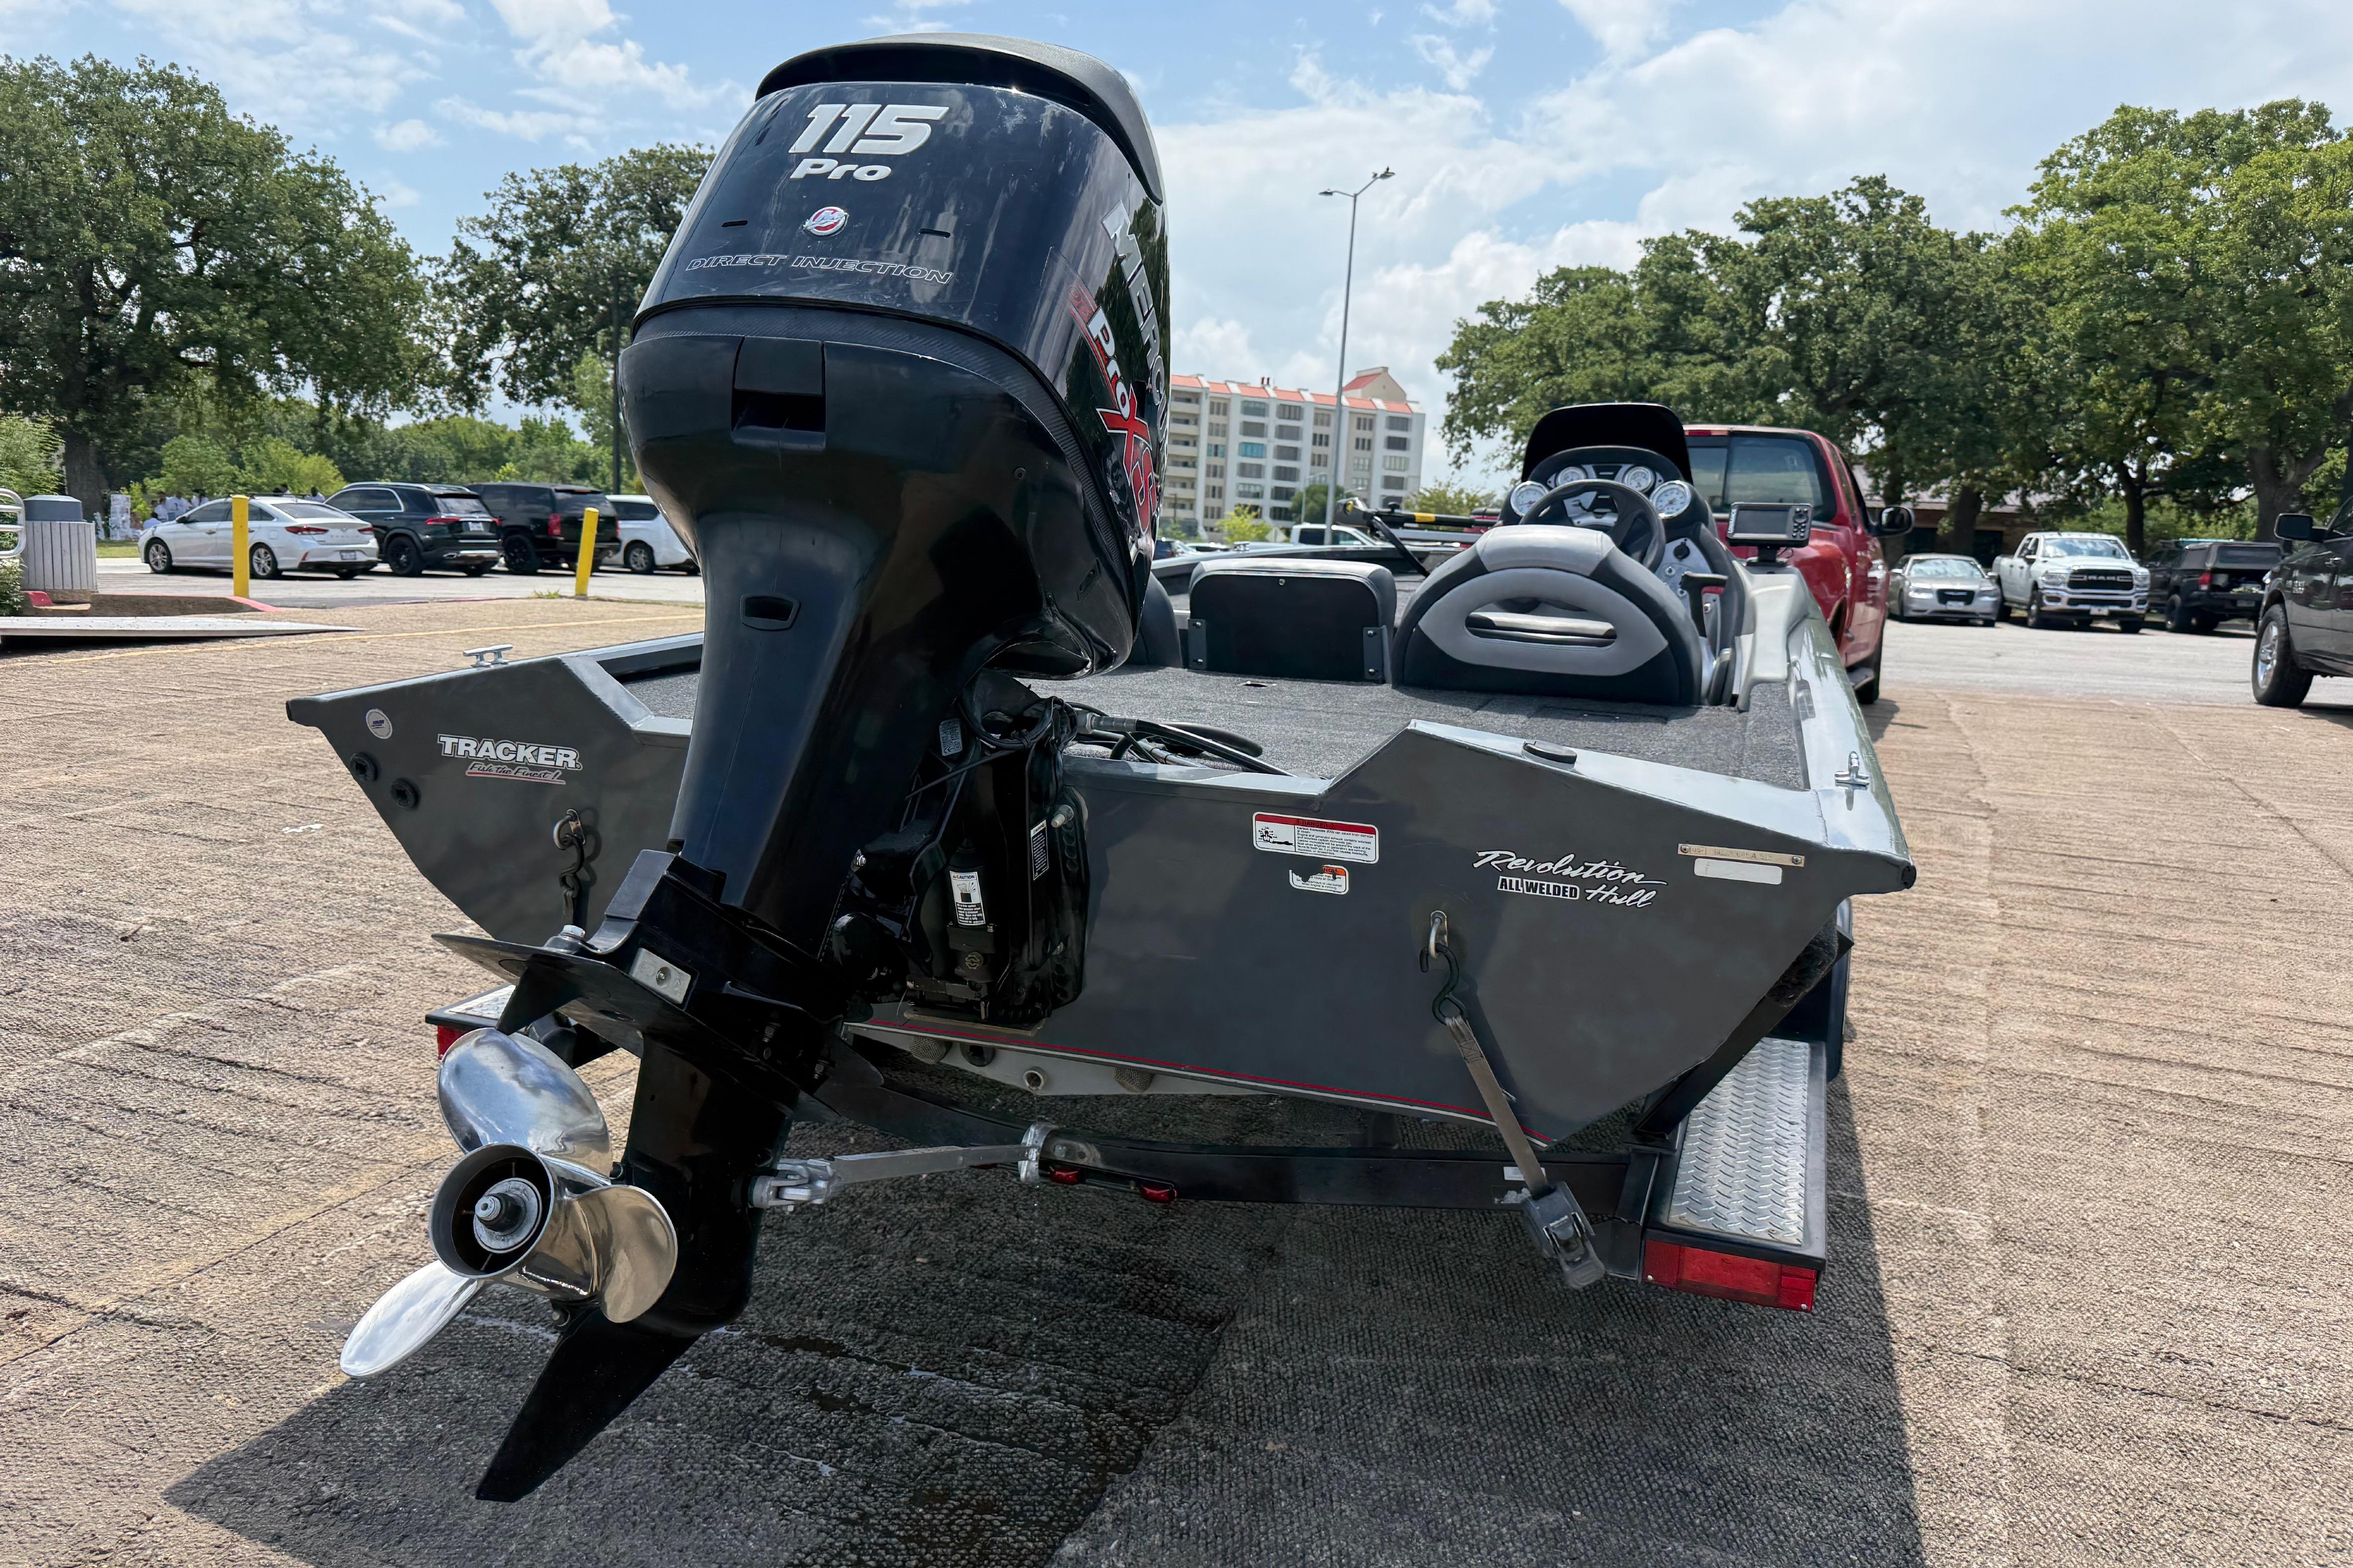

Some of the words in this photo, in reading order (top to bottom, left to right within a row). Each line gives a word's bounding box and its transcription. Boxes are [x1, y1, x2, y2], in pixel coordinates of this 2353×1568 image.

[788, 103, 949, 155] 115
[790, 158, 892, 181] Pro
[686, 254, 787, 271] DIRECT
[791, 256, 953, 285] INJECTION
[438, 734, 579, 769] TRACKER
[469, 762, 494, 773] Fish
[495, 764, 512, 775] the
[1473, 850, 1667, 885] Revolution
[1499, 878, 1524, 892] ALL
[1525, 881, 1578, 898] WELDED
[1584, 884, 1657, 908] Hull
